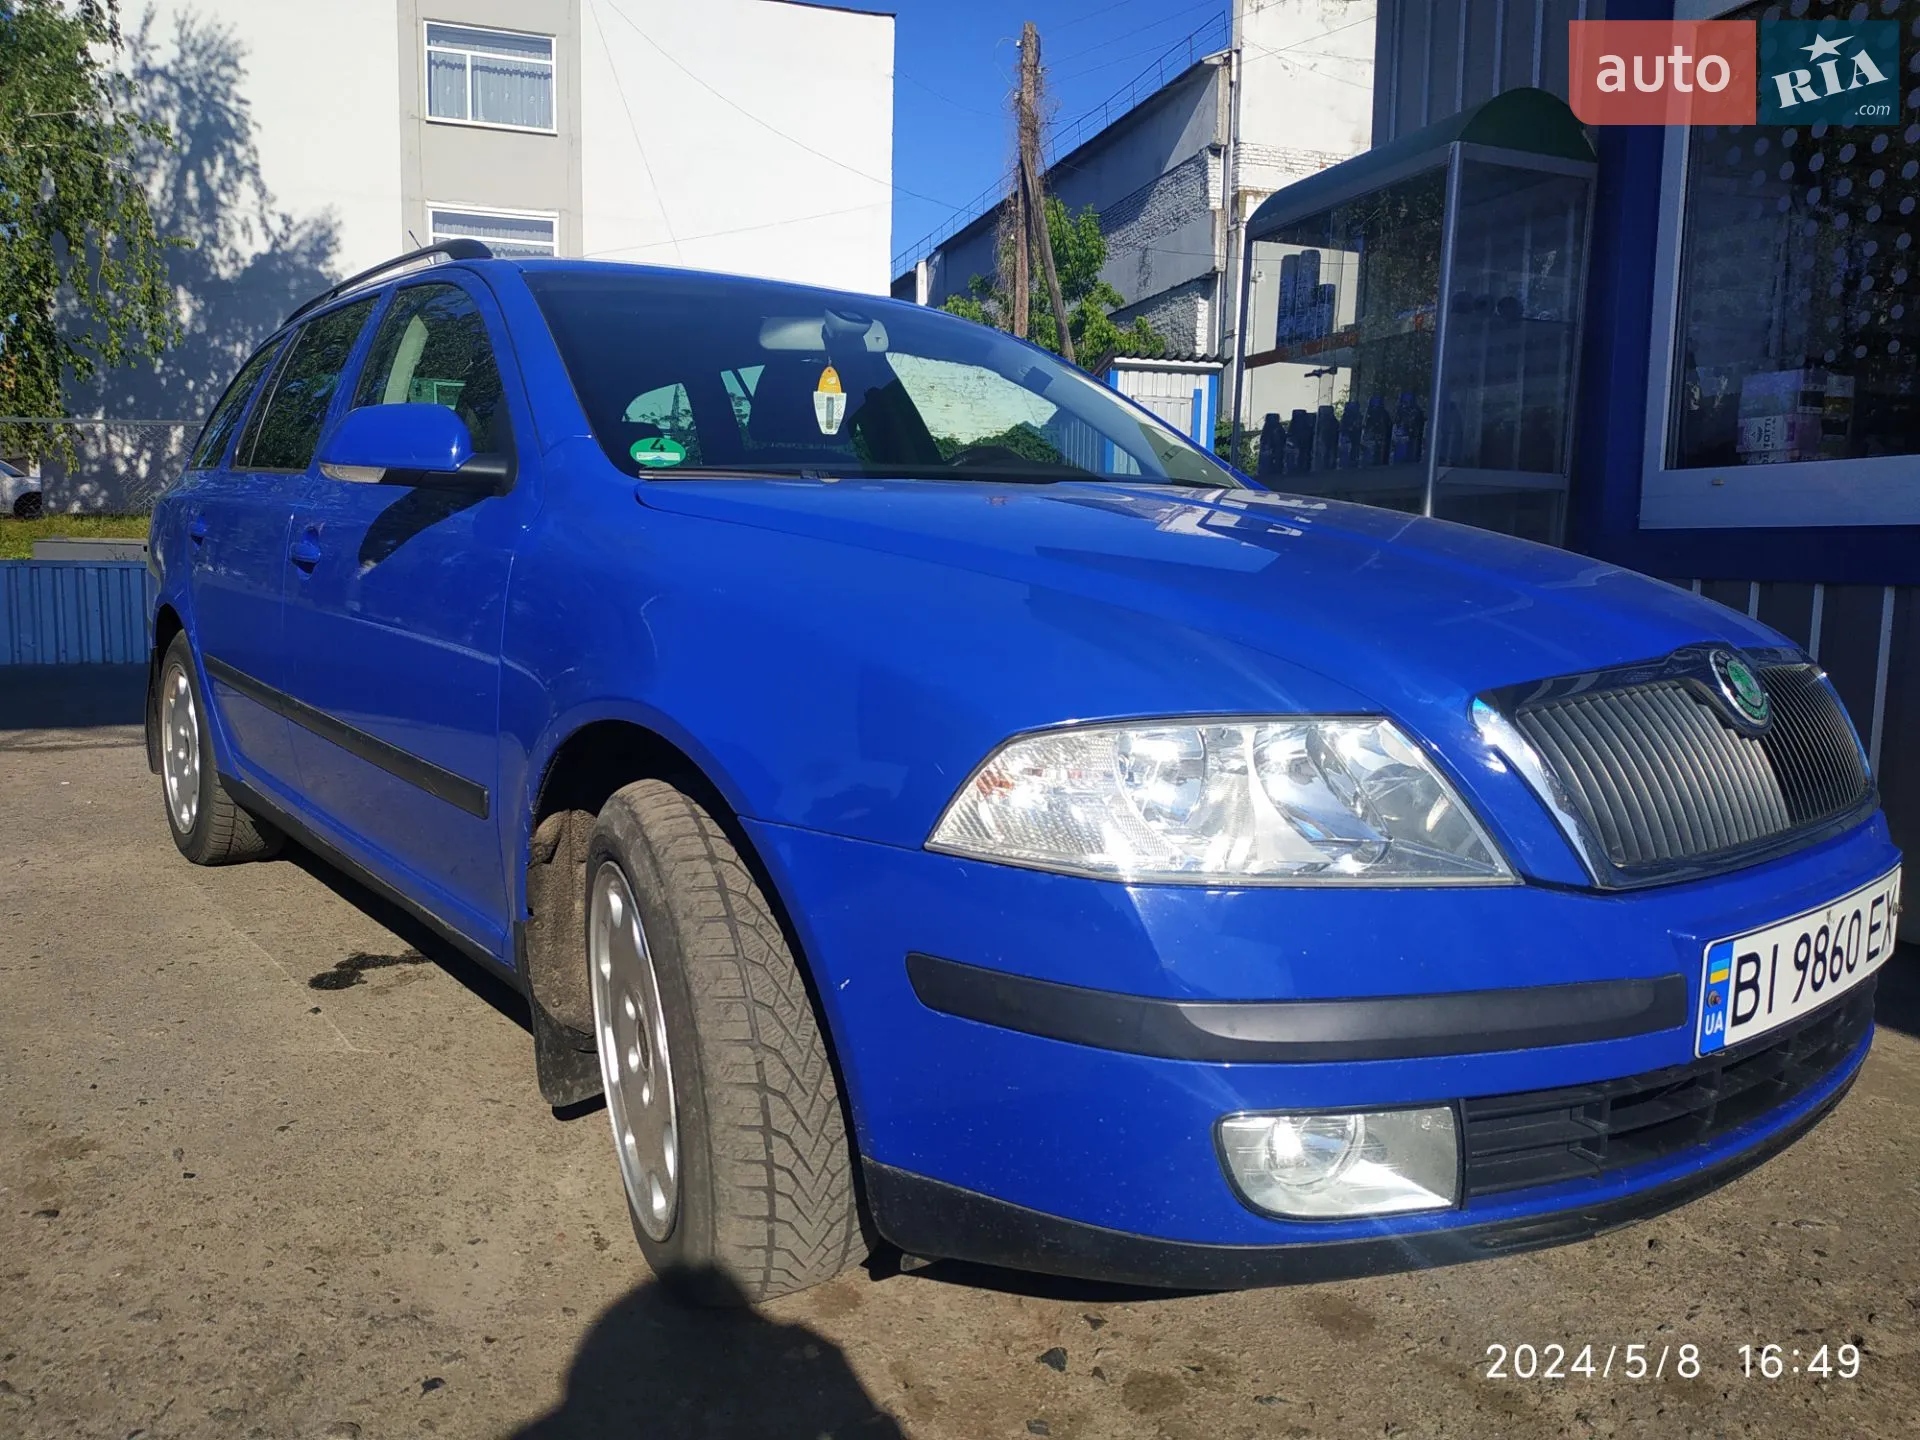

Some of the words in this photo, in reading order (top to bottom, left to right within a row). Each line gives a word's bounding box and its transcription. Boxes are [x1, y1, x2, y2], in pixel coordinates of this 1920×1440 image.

[650, 439, 666, 452] 4
[1792, 909, 1861, 1004] 9860
[1704, 1010, 1724, 1036] UA
